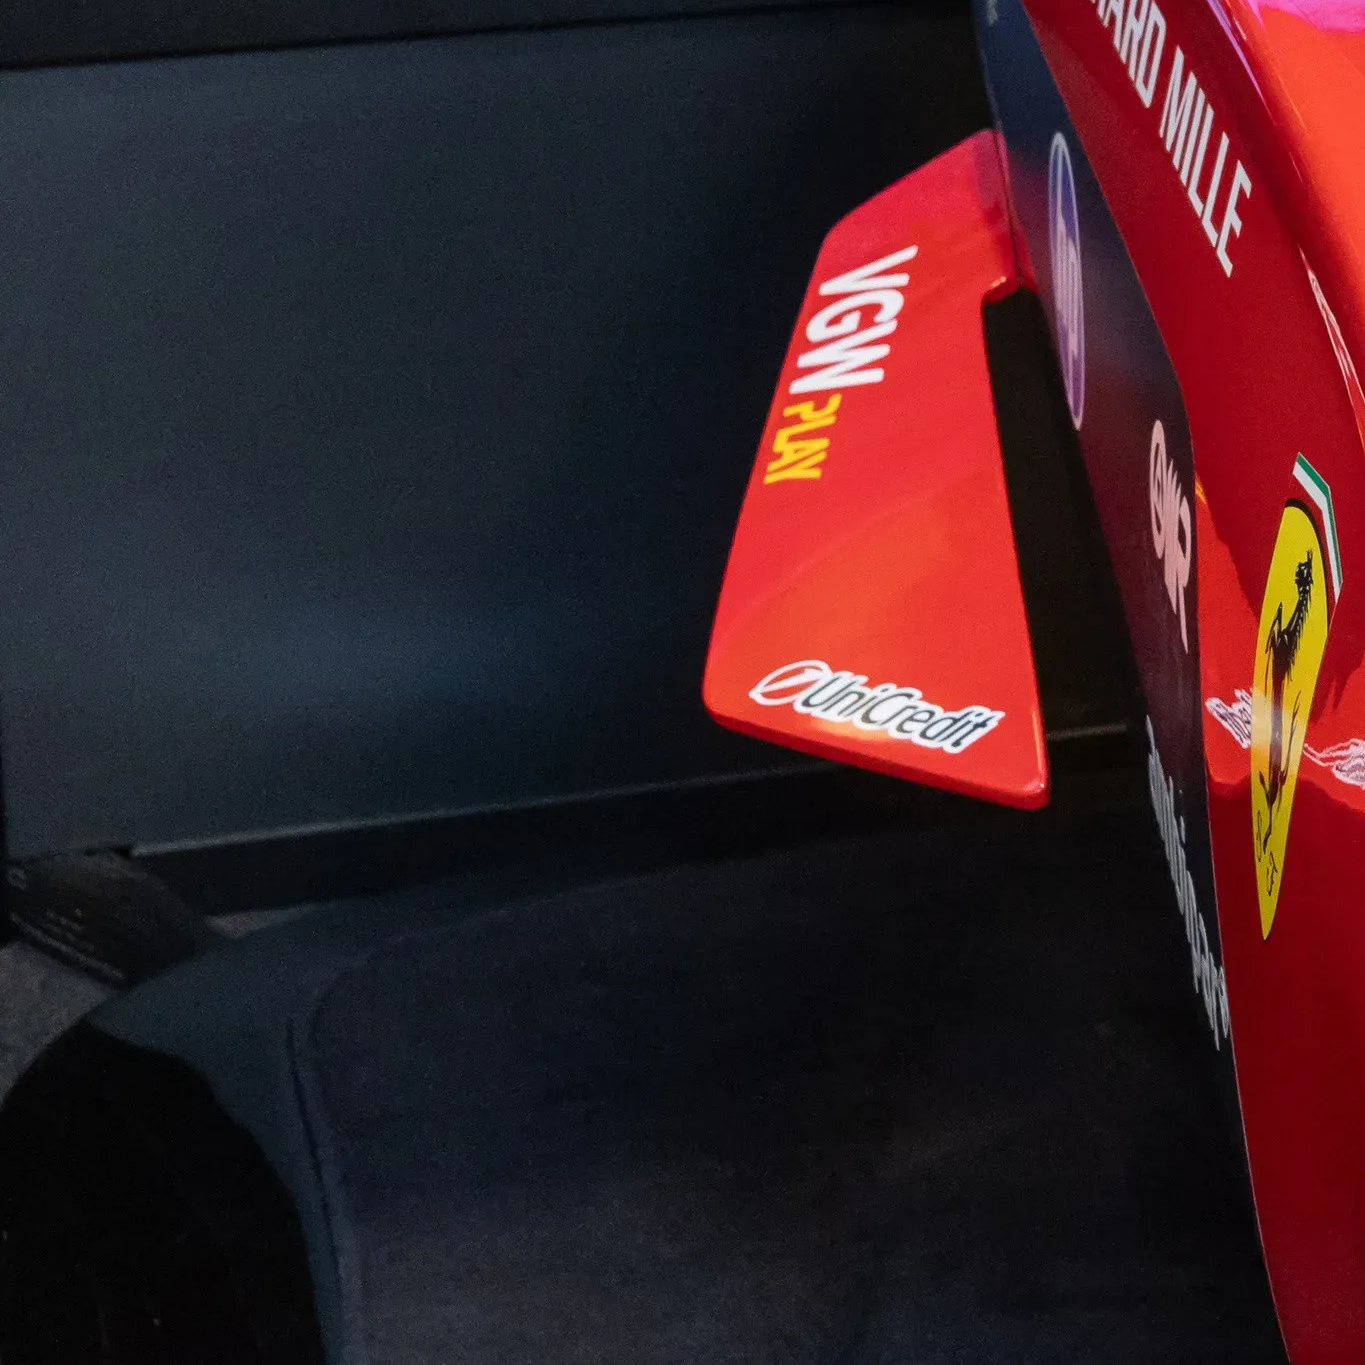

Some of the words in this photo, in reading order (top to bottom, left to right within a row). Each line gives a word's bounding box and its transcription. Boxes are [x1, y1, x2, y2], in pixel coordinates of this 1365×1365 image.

[1158, 44, 1253, 279] MILLE
[788, 244, 919, 395] VGW
[763, 393, 843, 485] PLAY
[796, 671, 1001, 752] UniCredit
